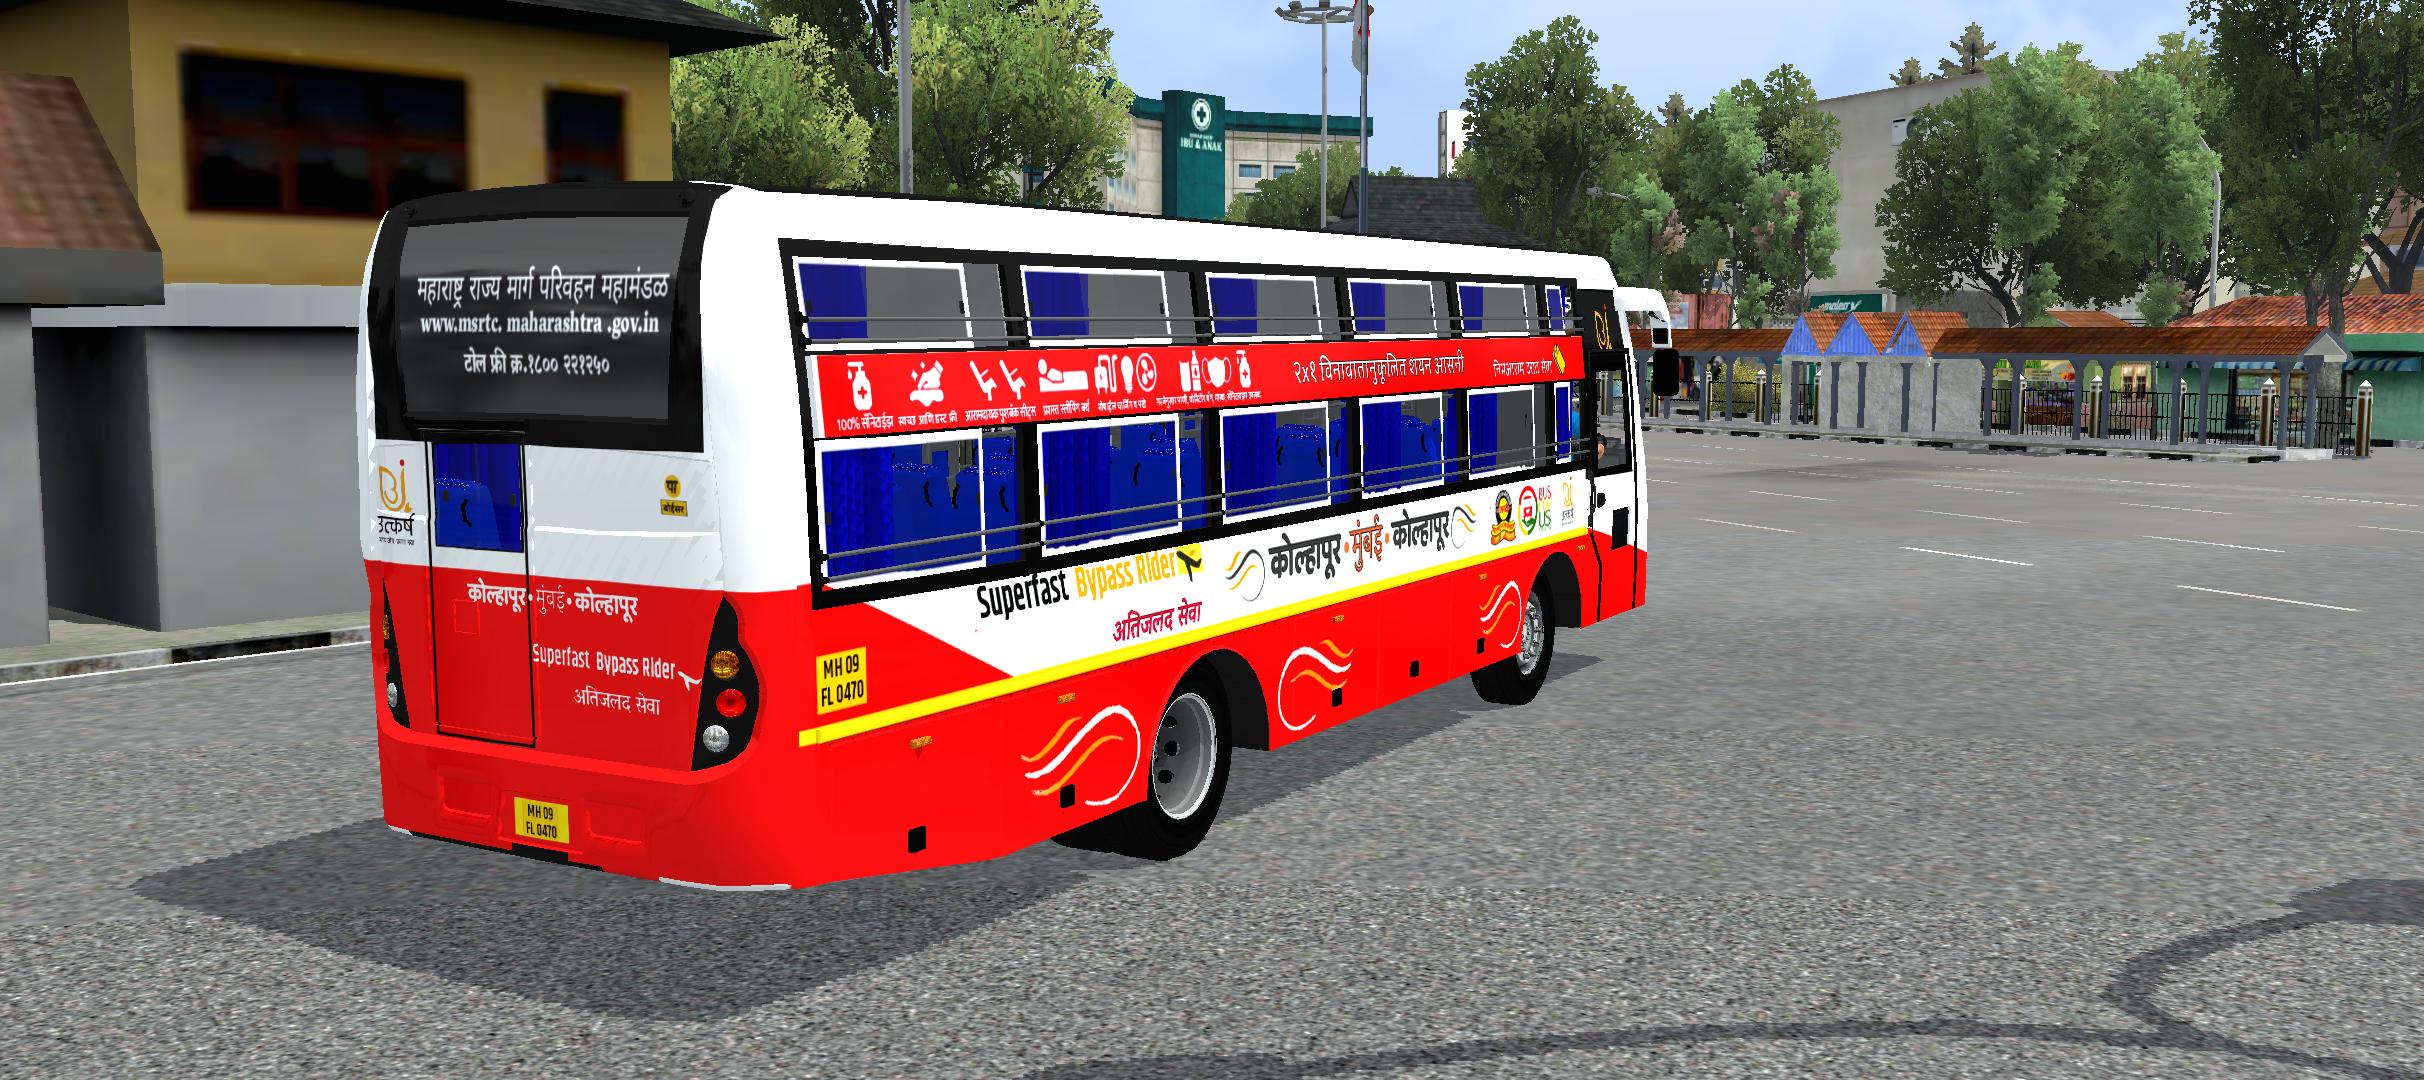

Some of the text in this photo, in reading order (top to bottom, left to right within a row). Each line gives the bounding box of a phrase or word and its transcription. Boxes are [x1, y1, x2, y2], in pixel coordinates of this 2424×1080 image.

[1202, 140, 1223, 152] ANAK
[418, 265, 670, 308] महाराष्ट्र राज्य मार्ग परिवहन महामंडळ
[506, 310, 602, 334] maharashtra
[607, 310, 660, 339] .gov.in
[463, 346, 486, 373] टोल
[490, 346, 507, 374] फ्री
[563, 354, 611, 376] २२१२५०
[1409, 357, 1432, 377] शयन
[1433, 348, 1465, 375] आसनी
[837, 416, 860, 431] 100%
[377, 512, 416, 536] उत्कर्ष
[1538, 509, 1552, 528] US
[1268, 508, 1451, 580] कोल्हापूर मुंबई कोल्हापूर
[466, 577, 639, 624] कोल्हापूर मुंबई कोल्हापूर
[977, 570, 1070, 620] Superfast
[1075, 564, 1134, 601] Bypass
[1112, 597, 1203, 643] अतिजलद सेवा
[532, 643, 591, 669] Superfast
[596, 651, 640, 677] Bypass
[823, 653, 860, 680] MH 09
[574, 685, 661, 716] अतिजलद सेवा
[821, 679, 864, 708] FL 0470
[527, 803, 554, 820] MH 09
[526, 821, 557, 839] FL 0470
